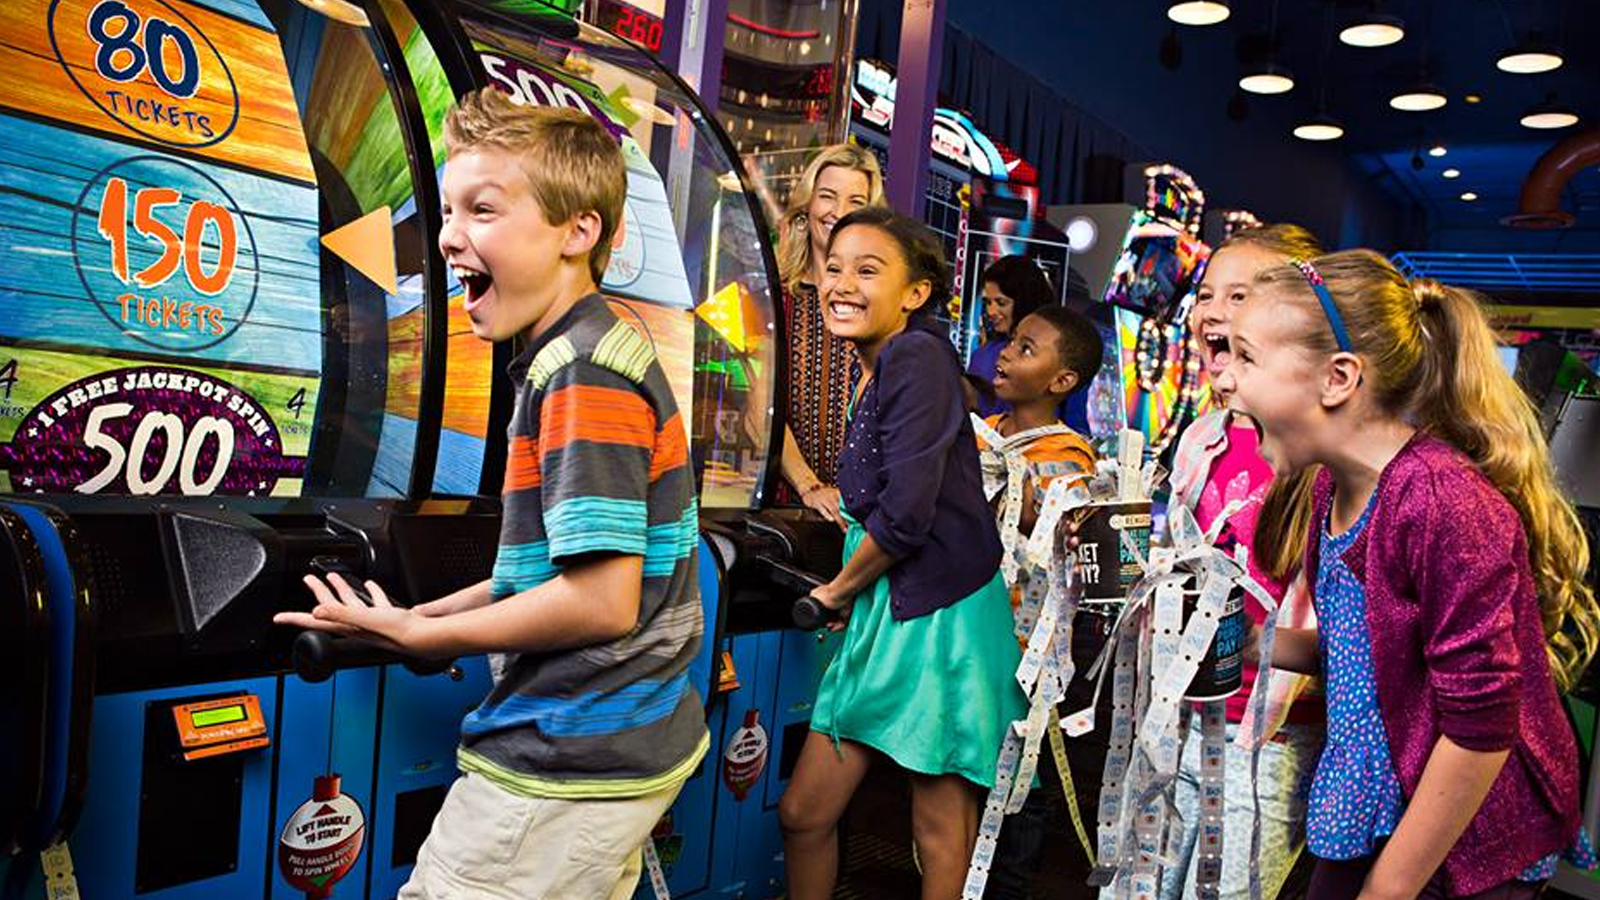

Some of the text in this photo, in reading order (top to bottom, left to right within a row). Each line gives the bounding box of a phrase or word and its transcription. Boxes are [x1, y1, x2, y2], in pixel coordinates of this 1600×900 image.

[89, 0, 200, 98] 80
[616, 7, 664, 53] 260
[105, 90, 215, 138] TICKETS
[98, 177, 238, 295] 150
[116, 293, 224, 335] TICKETS
[51, 376, 119, 417] FREE
[123, 372, 229, 403] JACKPOT
[227, 393, 271, 437] SPIN
[286, 386, 306, 420] 4
[73, 402, 235, 496] 500
[296, 815, 351, 836] LIFT HANDLE
[304, 828, 343, 845] TO START
